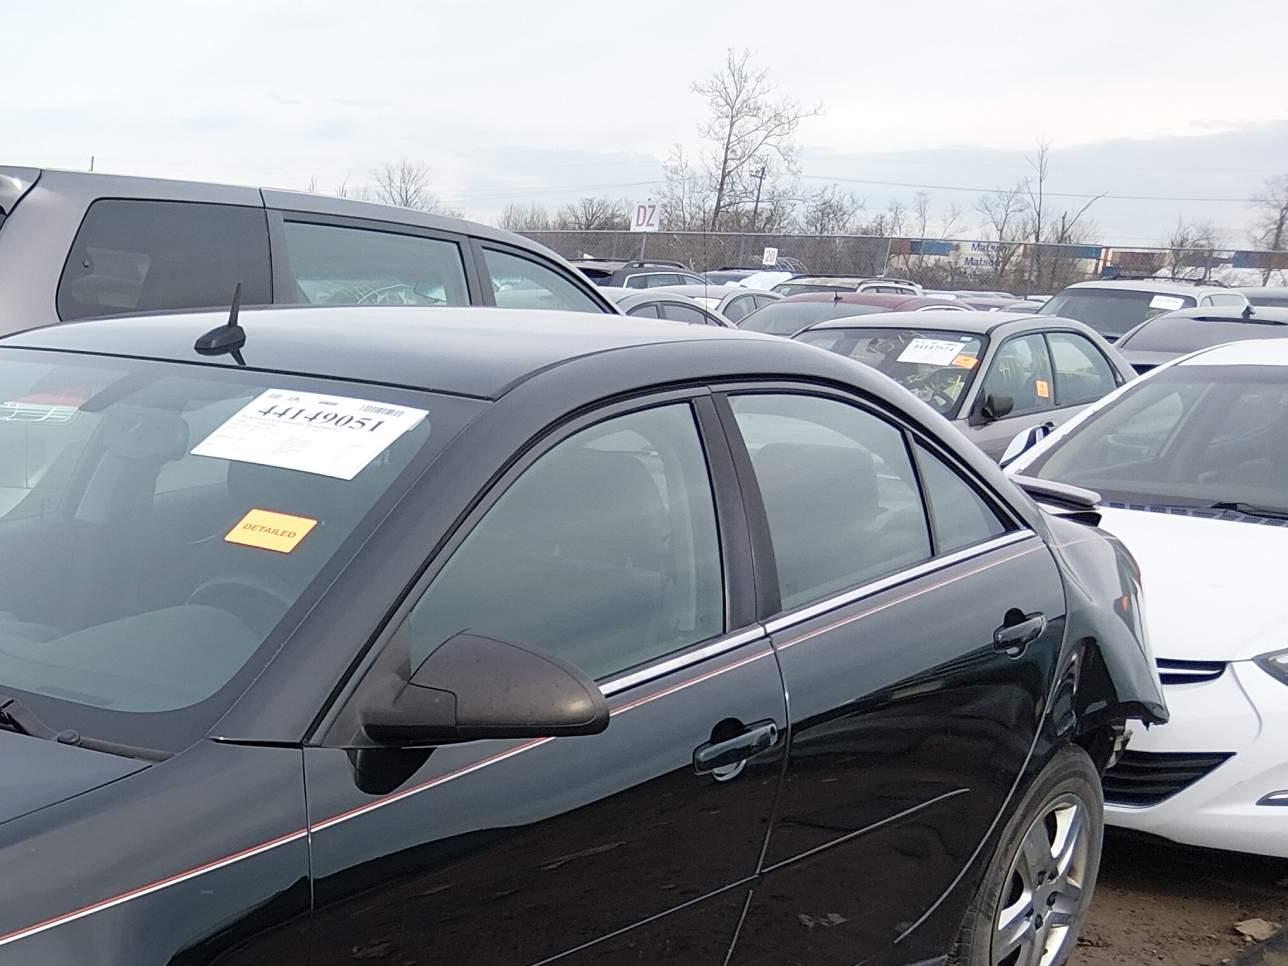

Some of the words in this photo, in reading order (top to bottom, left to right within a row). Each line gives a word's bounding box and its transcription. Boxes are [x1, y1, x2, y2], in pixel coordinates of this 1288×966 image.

[636, 204, 657, 227] DZ
[258, 404, 385, 432] 44149051
[243, 521, 298, 539] DETAILED
